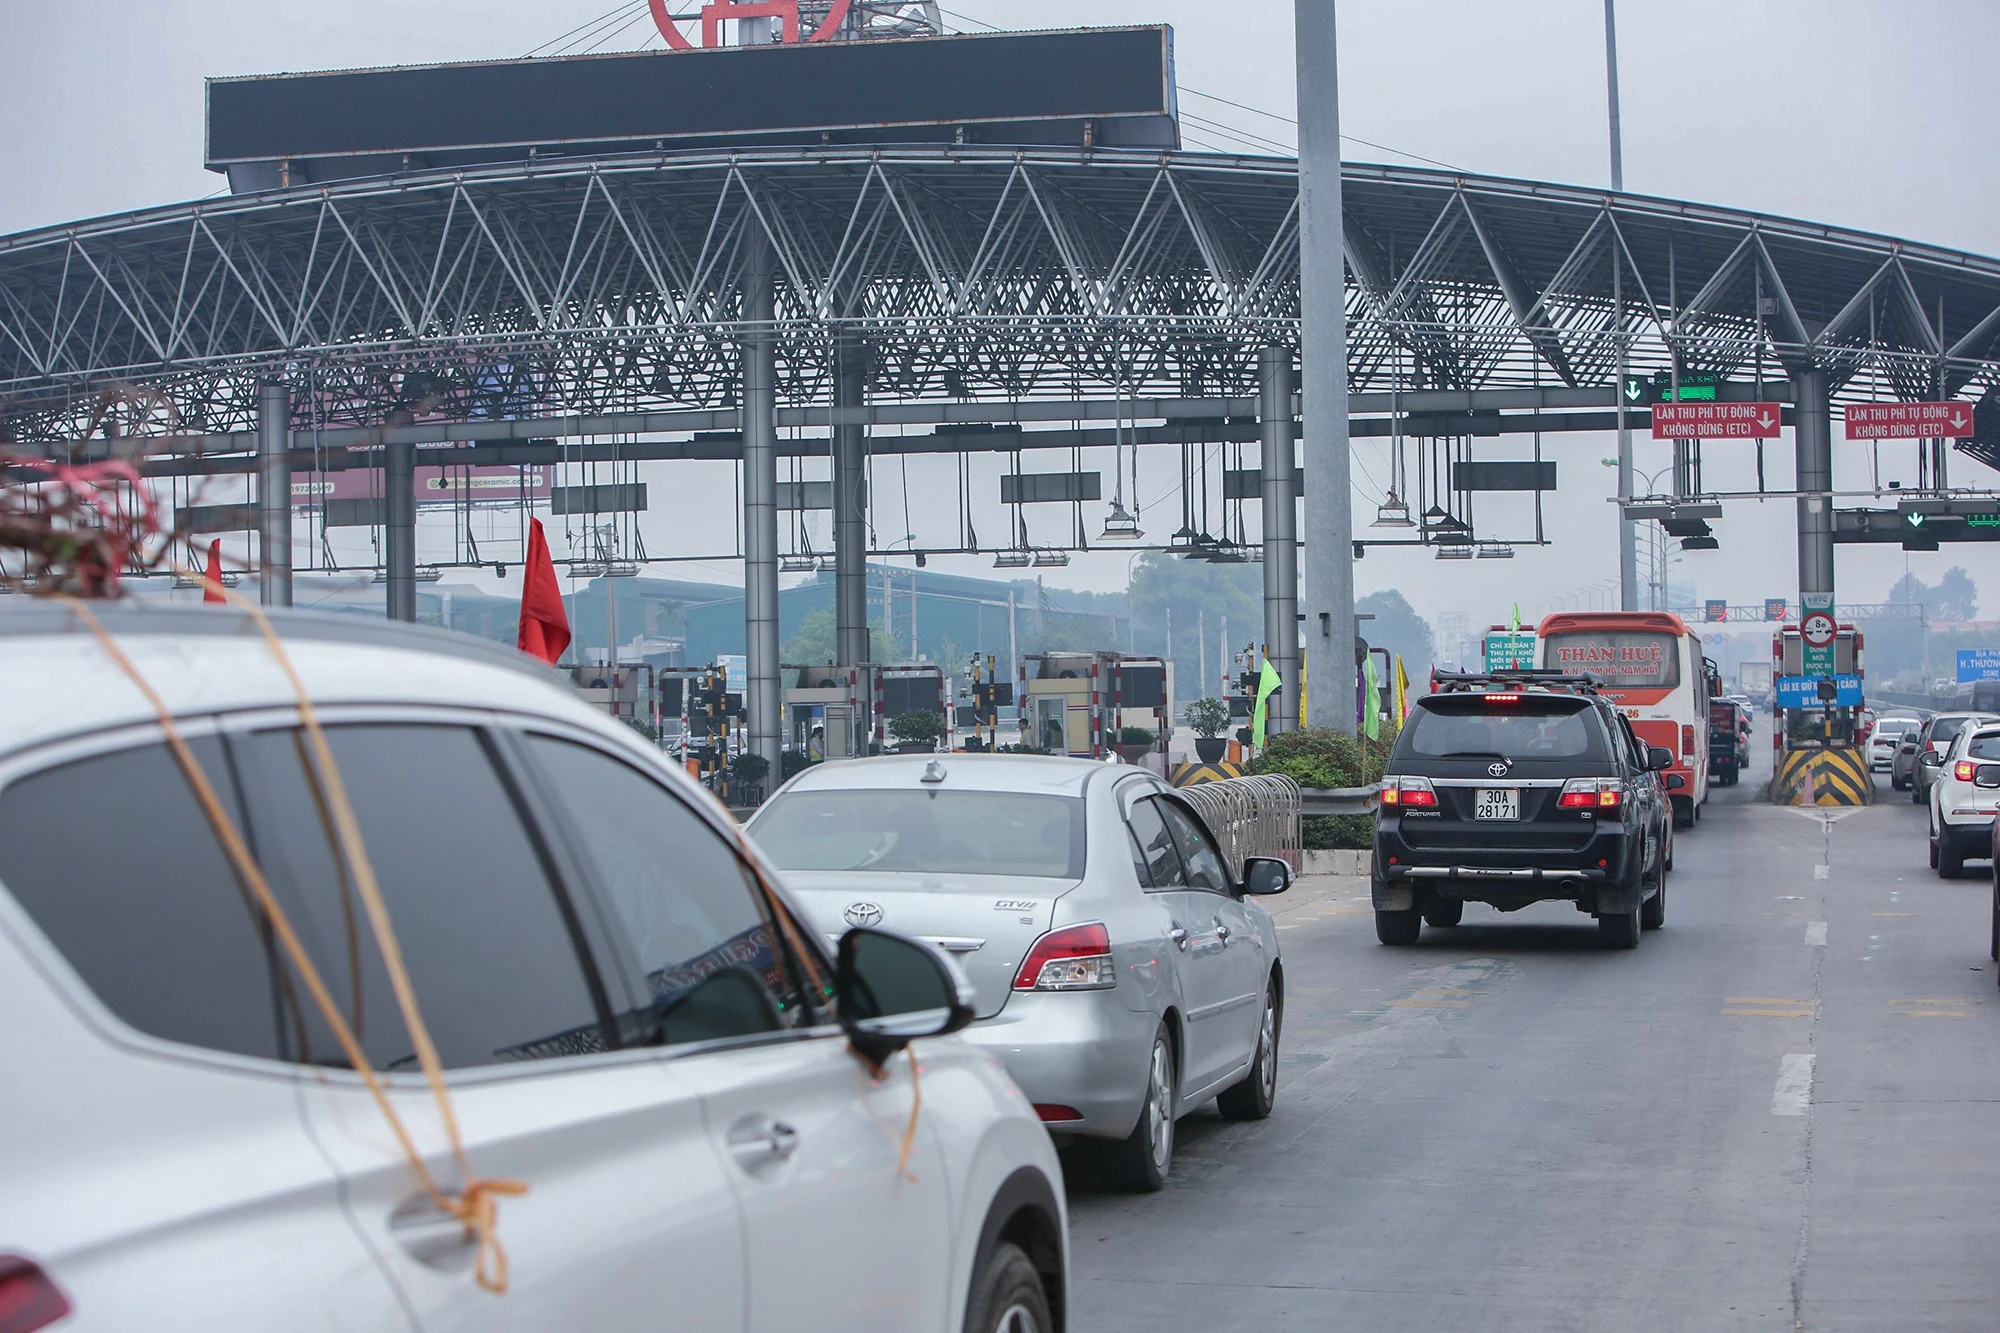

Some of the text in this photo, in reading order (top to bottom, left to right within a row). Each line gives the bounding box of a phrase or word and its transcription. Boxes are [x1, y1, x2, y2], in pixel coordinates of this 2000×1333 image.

[1656, 404, 1757, 420] LÀN THU PHÍ TỰ ĐỘNG
[1849, 404, 1949, 421] LÀN THU PHÍ TỰ ĐỘNG
[1662, 420, 1751, 436] KHÔNG DỪNG (ETC)
[1855, 421, 1944, 437] KHÔNG DỪNG (ETC)
[1791, 682, 1800, 691] XE
[1627, 708, 1639, 719] 26
[1486, 790, 1509, 804] 30A
[1478, 804, 1516, 818] 281.71
